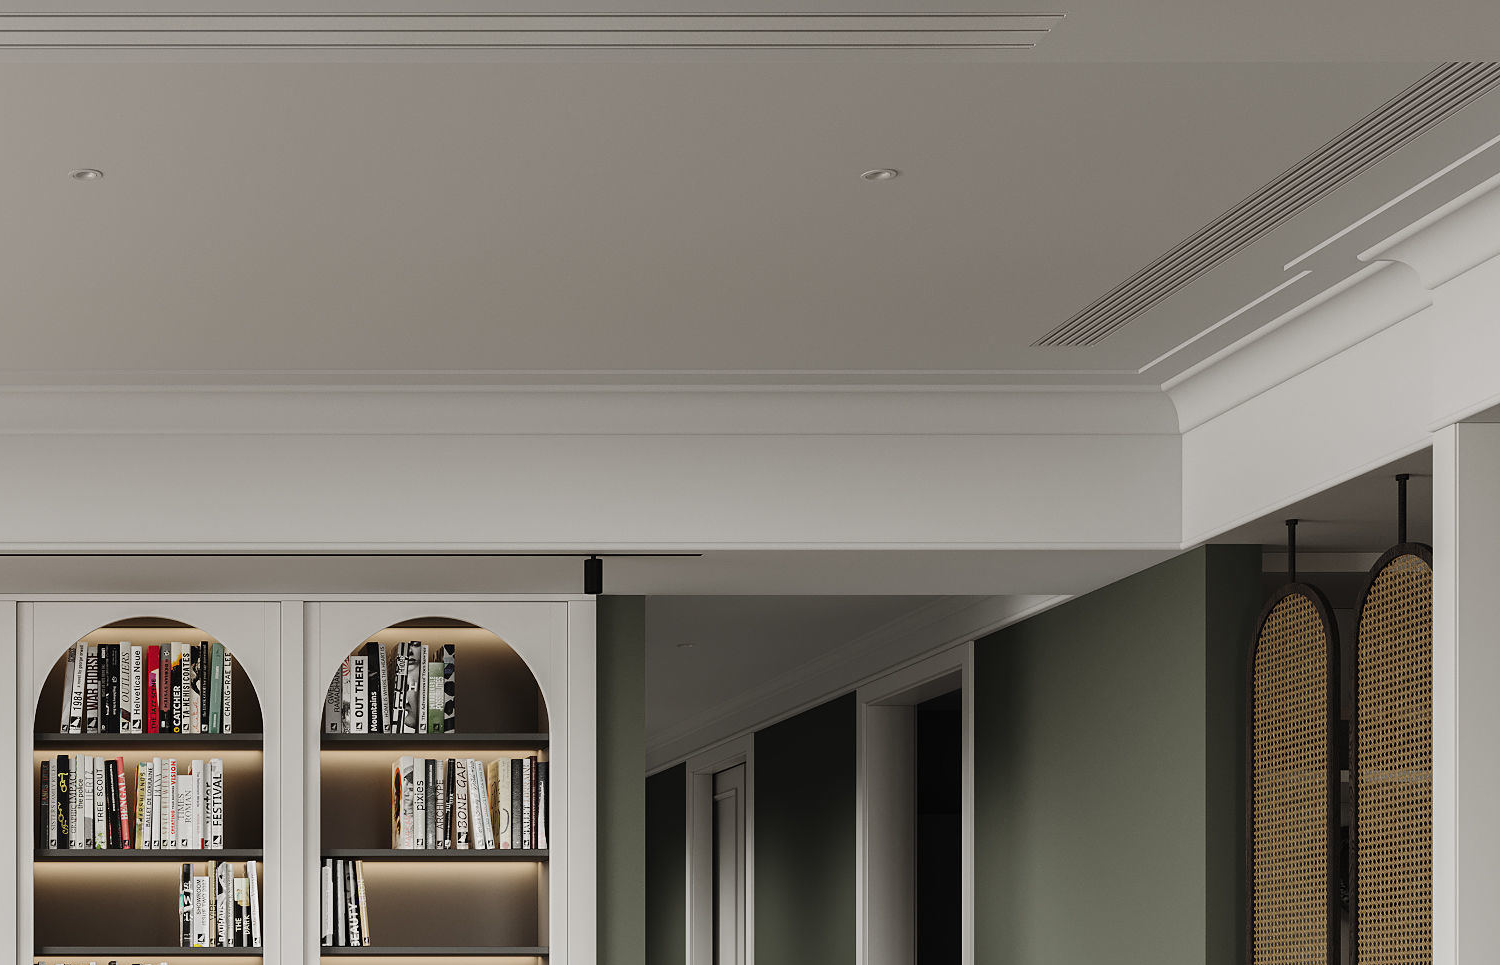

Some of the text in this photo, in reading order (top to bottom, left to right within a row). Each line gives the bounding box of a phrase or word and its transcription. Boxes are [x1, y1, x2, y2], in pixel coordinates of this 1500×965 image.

[87, 652, 98, 711] WAR HORSE
[121, 652, 130, 703] OUTLIERS
[355, 659, 364, 718] OUT THERE
[73, 691, 83, 711] 1984
[173, 685, 181, 727] CATCHER
[369, 691, 377, 732] Mountains
[69, 770, 77, 804] IMPACT
[96, 768, 104, 797] SCOUT
[117, 772, 129, 820] BENGALA
[147, 797, 152, 806] DE
[213, 773, 222, 826] FESTIVAL
[414, 780, 426, 811] pixies
[457, 761, 468, 829] BONE GAP
[184, 789, 192, 823] ROMAN
[218, 904, 226, 943] BAUHAUS
[348, 903, 360, 946] BEAUTY
